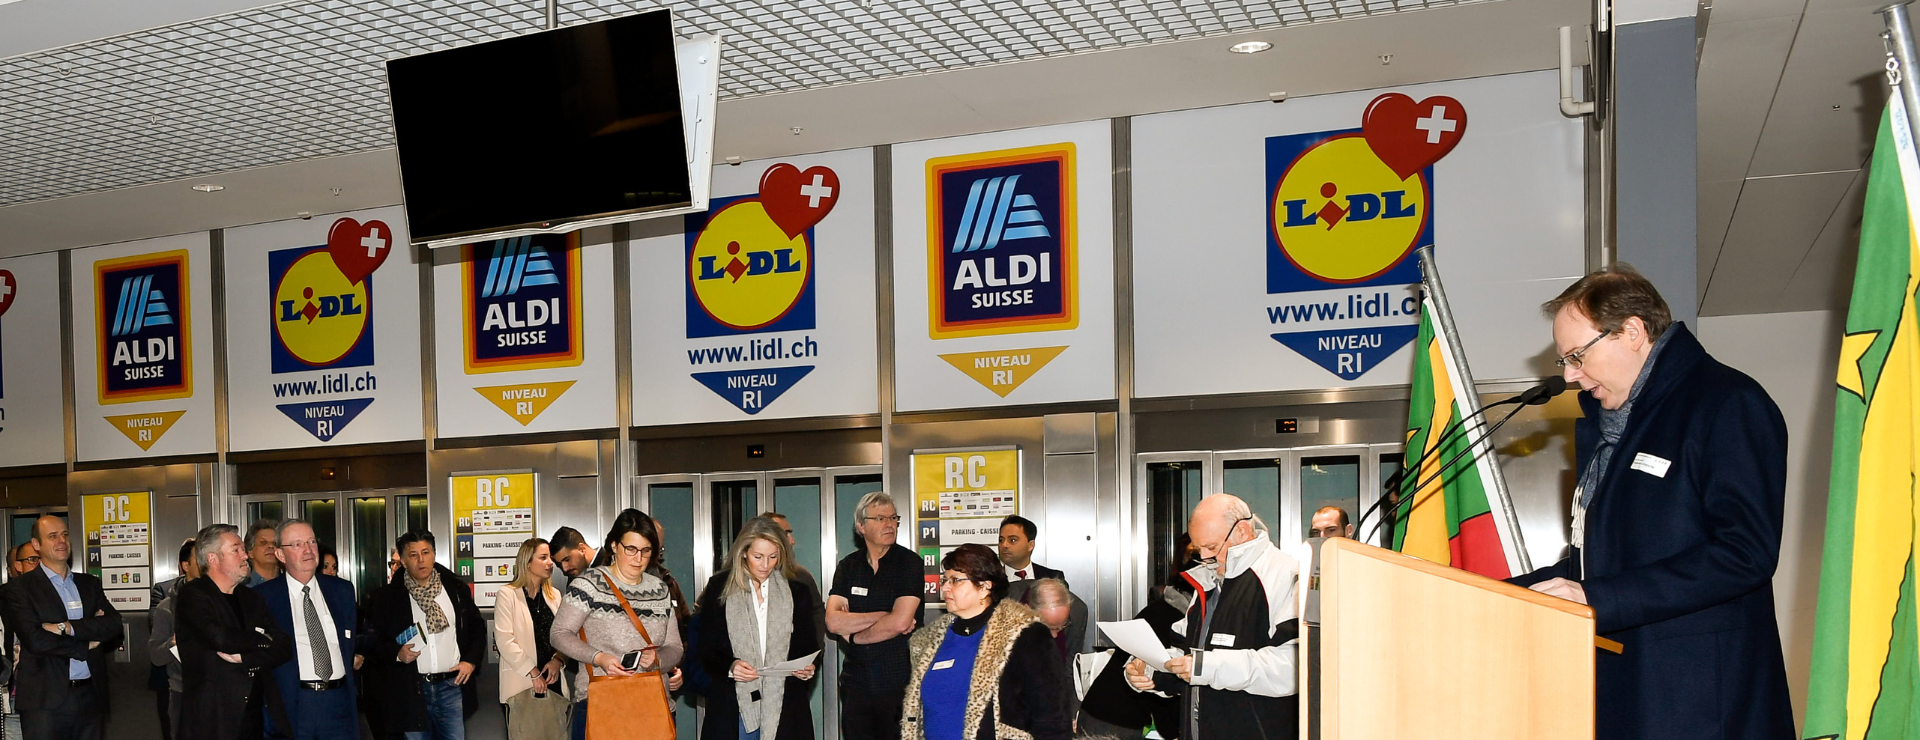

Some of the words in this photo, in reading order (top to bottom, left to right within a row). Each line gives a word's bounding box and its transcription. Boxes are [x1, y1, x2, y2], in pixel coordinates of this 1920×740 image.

[952, 252, 1052, 290] ALDI
[971, 288, 1034, 309] SUISSE
[482, 297, 561, 331] ALDI
[497, 330, 547, 347] SUISSE
[1317, 332, 1382, 351] NIVEAU
[112, 336, 175, 366] ALDI
[687, 336, 818, 365] www.lidl.ch
[973, 354, 1031, 369] NIVEAU
[1338, 353, 1363, 374] RI
[124, 365, 164, 381] SUISSE
[992, 370, 1013, 386] RI
[273, 372, 377, 398] www.lidl.ch
[727, 374, 777, 389] NIVEAU
[502, 387, 547, 401] NIVEAU
[742, 391, 762, 409] RI
[304, 405, 345, 419] NIVEAU
[516, 401, 533, 416] RI
[126, 416, 163, 428] NIVEAU
[317, 420, 333, 437] RI
[138, 429, 152, 442] RI
[944, 455, 986, 489] RC
[476, 477, 510, 507] RC
[103, 495, 130, 522] RC
[921, 499, 936, 512] RC
[458, 516, 471, 528] RC
[89, 531, 99, 541] RC
[922, 527, 936, 539] P1
[951, 528, 976, 536] PARKING
[460, 541, 471, 552] P1
[90, 552, 100, 562] P1
[924, 554, 935, 567] RI
[461, 565, 471, 576] RI
[924, 581, 937, 594] P2
